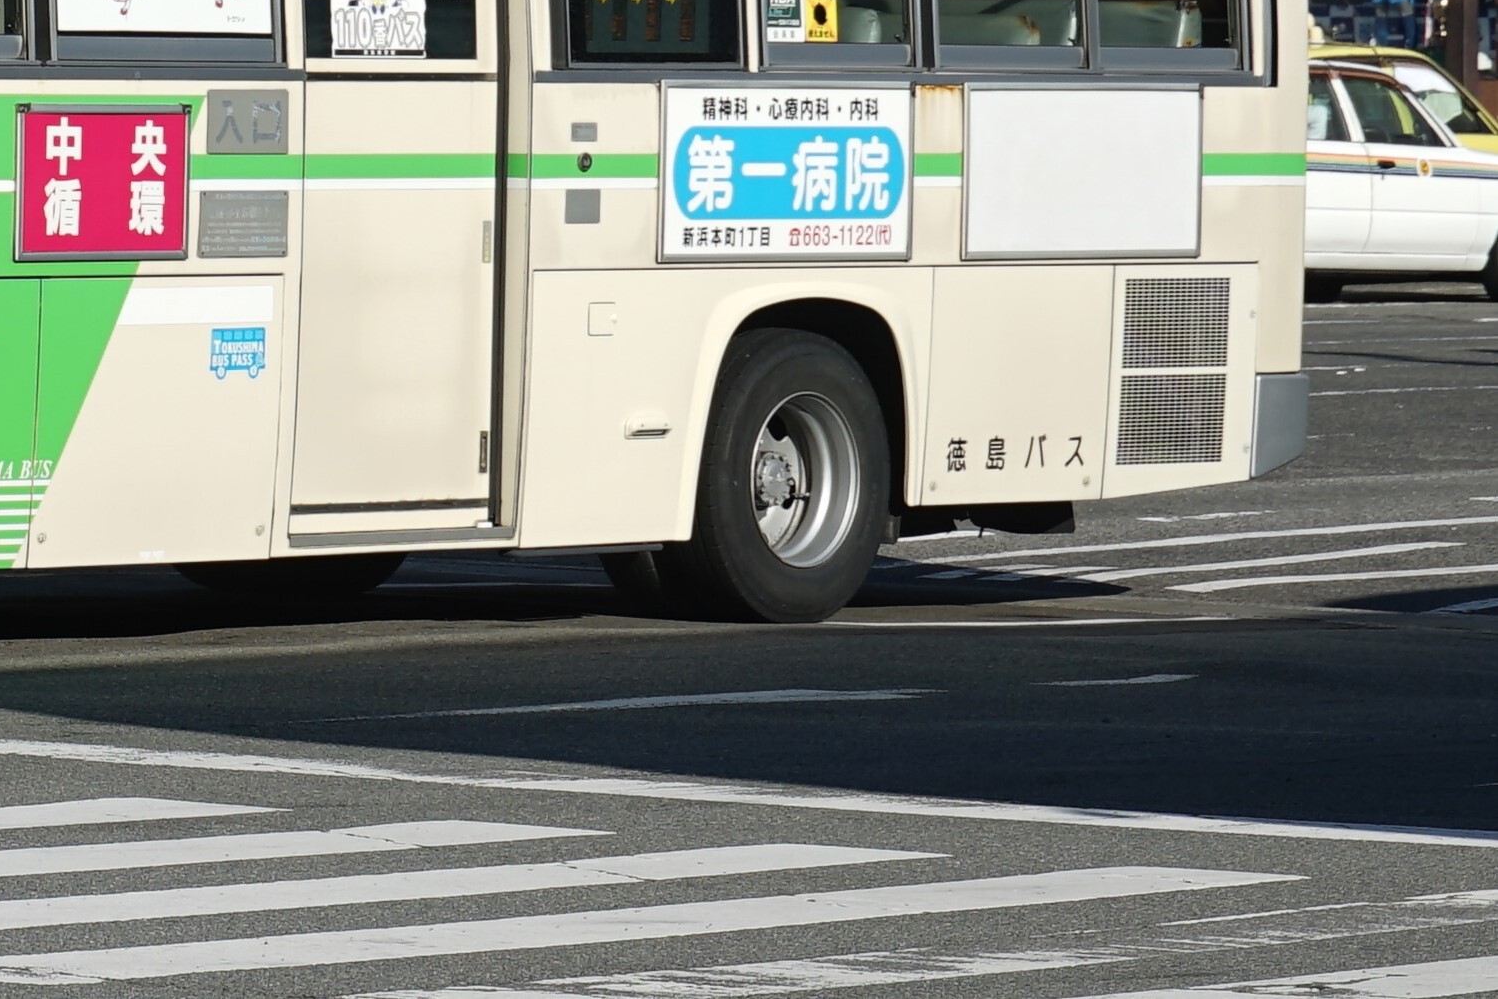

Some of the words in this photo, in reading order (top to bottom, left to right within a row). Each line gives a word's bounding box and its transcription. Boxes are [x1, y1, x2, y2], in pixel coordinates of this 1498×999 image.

[334, 7, 424, 49] 110番バス
[44, 116, 166, 177] 中央
[687, 134, 890, 212] 第一病院
[43, 178, 166, 237] 循環
[211, 354, 230, 367] BUS
[231, 353, 254, 367] PASS
[213, 339, 263, 354] TOKUSHIMA
[19, 458, 54, 480] BUS
[946, 434, 1085, 473] 徳島バス
